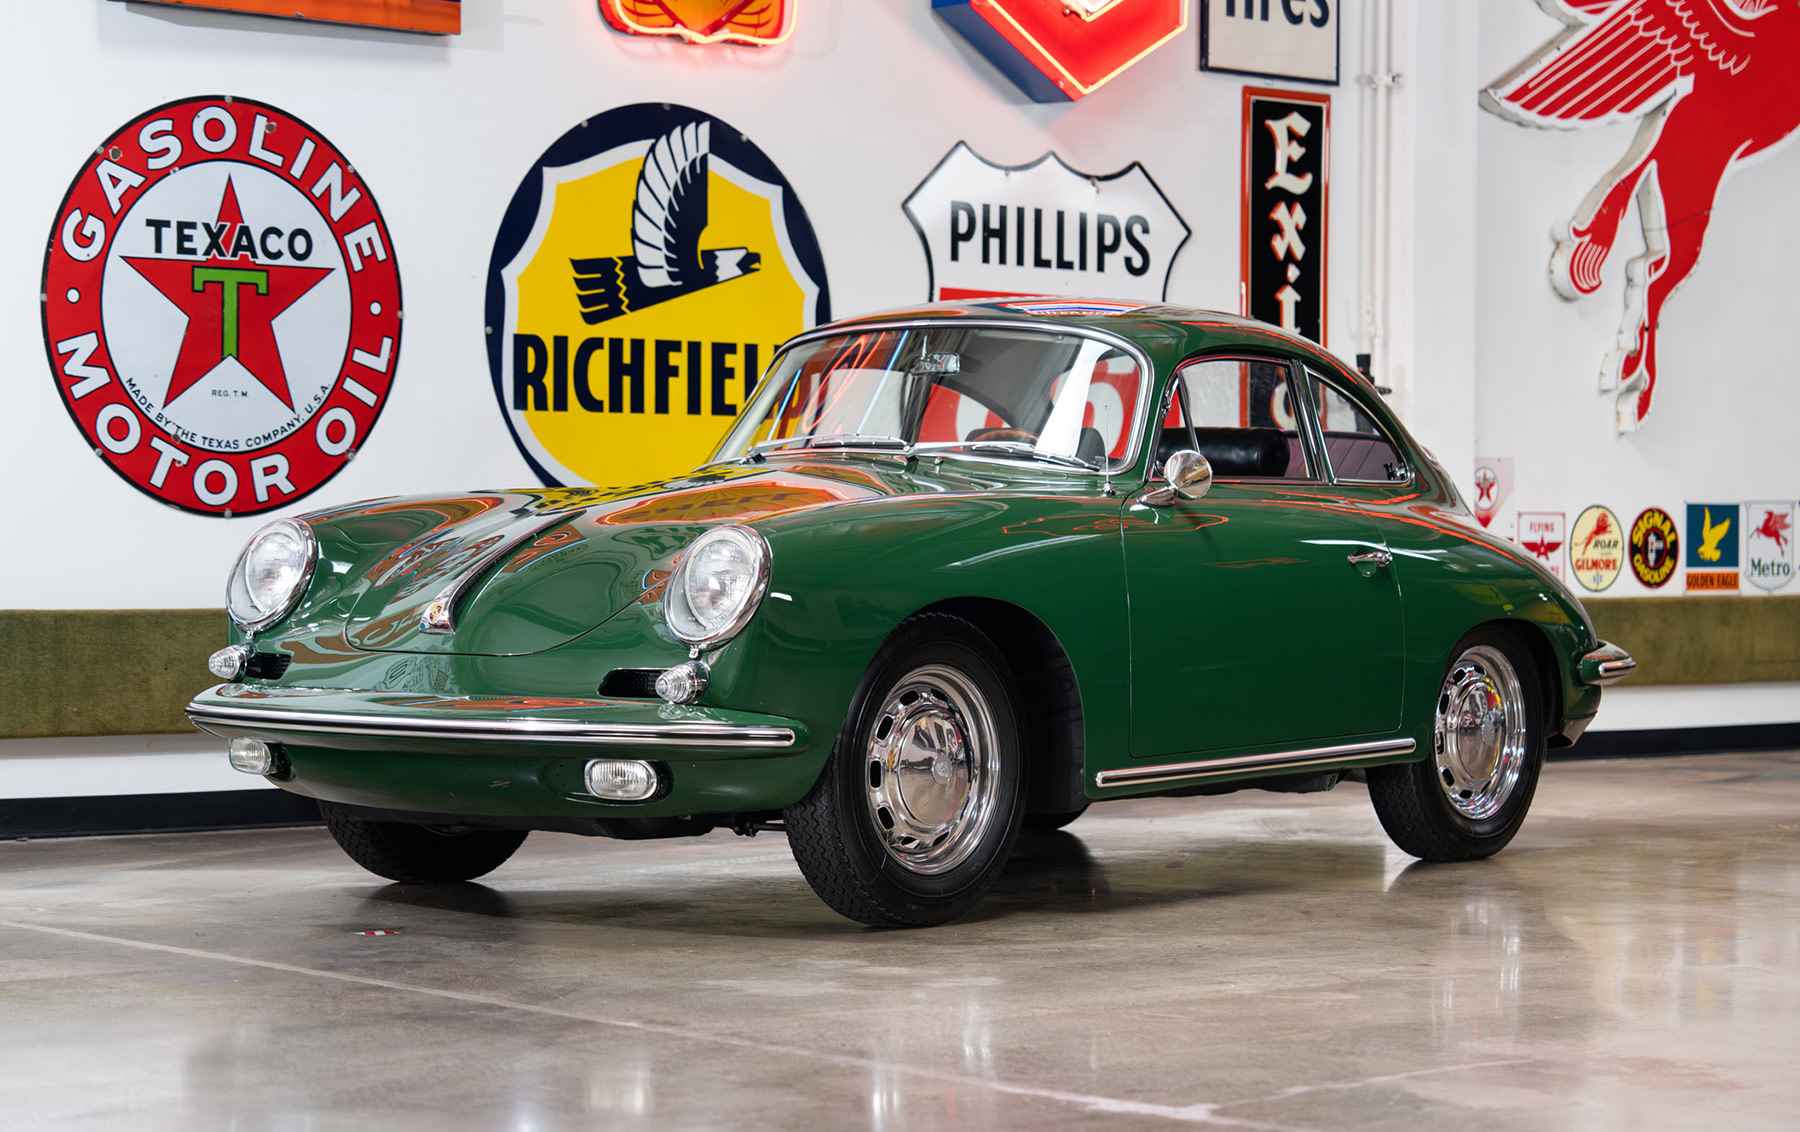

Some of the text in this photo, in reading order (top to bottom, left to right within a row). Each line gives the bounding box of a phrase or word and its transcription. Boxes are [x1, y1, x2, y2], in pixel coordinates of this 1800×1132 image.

[62, 106, 387, 273] GASOLINE
[145, 219, 313, 261] TEXACO
[950, 200, 1151, 277] PHILLIPS
[1264, 111, 1313, 431] Exi
[191, 265, 269, 359] T
[513, 333, 783, 417] RICHFIEL
[56, 331, 393, 506] MOTOR OIL
[125, 378, 154, 413] MADE
[155, 412, 172, 427] BY
[175, 424, 197, 442] THE
[201, 436, 240, 449] TEXAS
[1529, 522, 1555, 533] FLYING
[1592, 539, 1619, 549] ROAR
[1632, 511, 1676, 549] SIGNAL
[1575, 558, 1617, 571] GILMORE
[1633, 553, 1675, 584] GASOLINE
[1687, 573, 1737, 587] GOLDEN EAGLE
[1751, 557, 1790, 577] Metro
